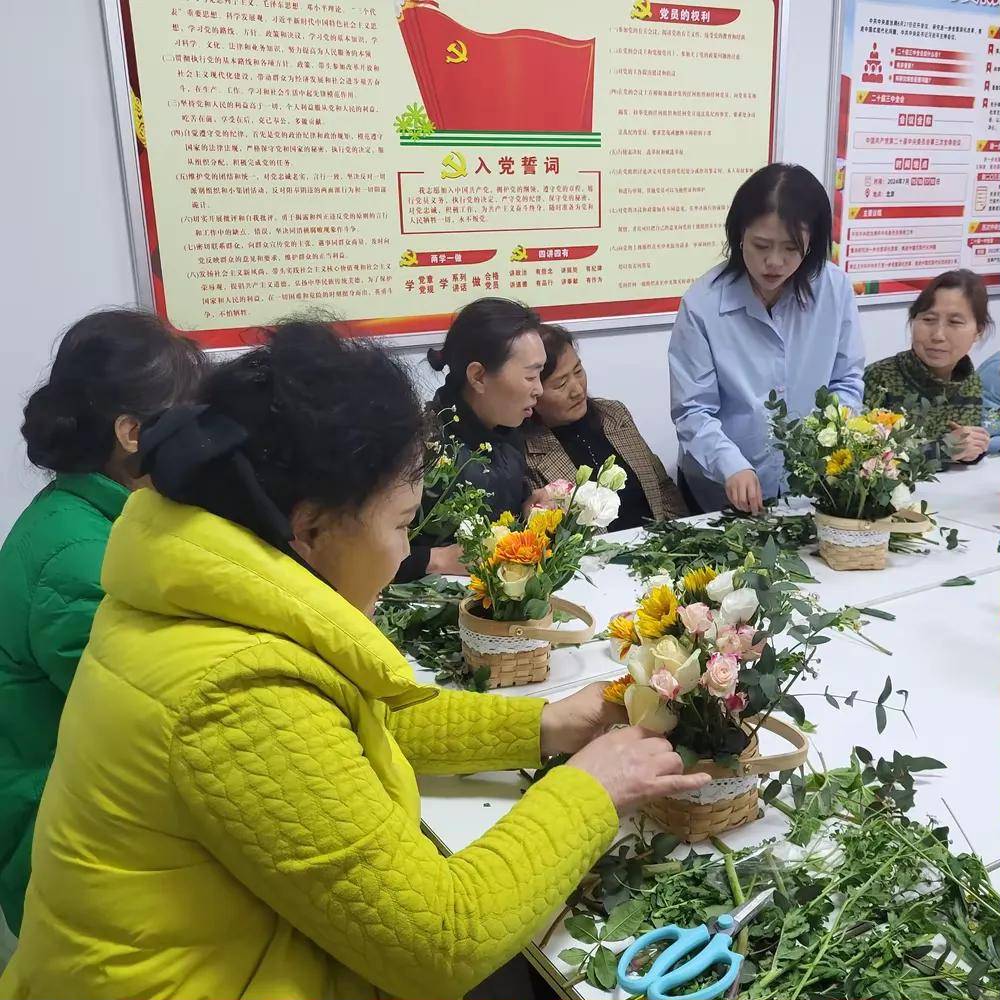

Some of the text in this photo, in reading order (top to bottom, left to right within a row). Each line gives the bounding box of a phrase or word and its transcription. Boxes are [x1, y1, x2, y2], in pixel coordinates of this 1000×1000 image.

[659, 8, 711, 23] 党员的权利
[474, 155, 560, 175] 入党誓词
[418, 275, 433, 285] 党章
[452, 272, 467, 283] 系列
[472, 276, 481, 288] 做
[484, 271, 499, 281] 合格
[405, 279, 415, 292] 学
[439, 277, 449, 290] 学
